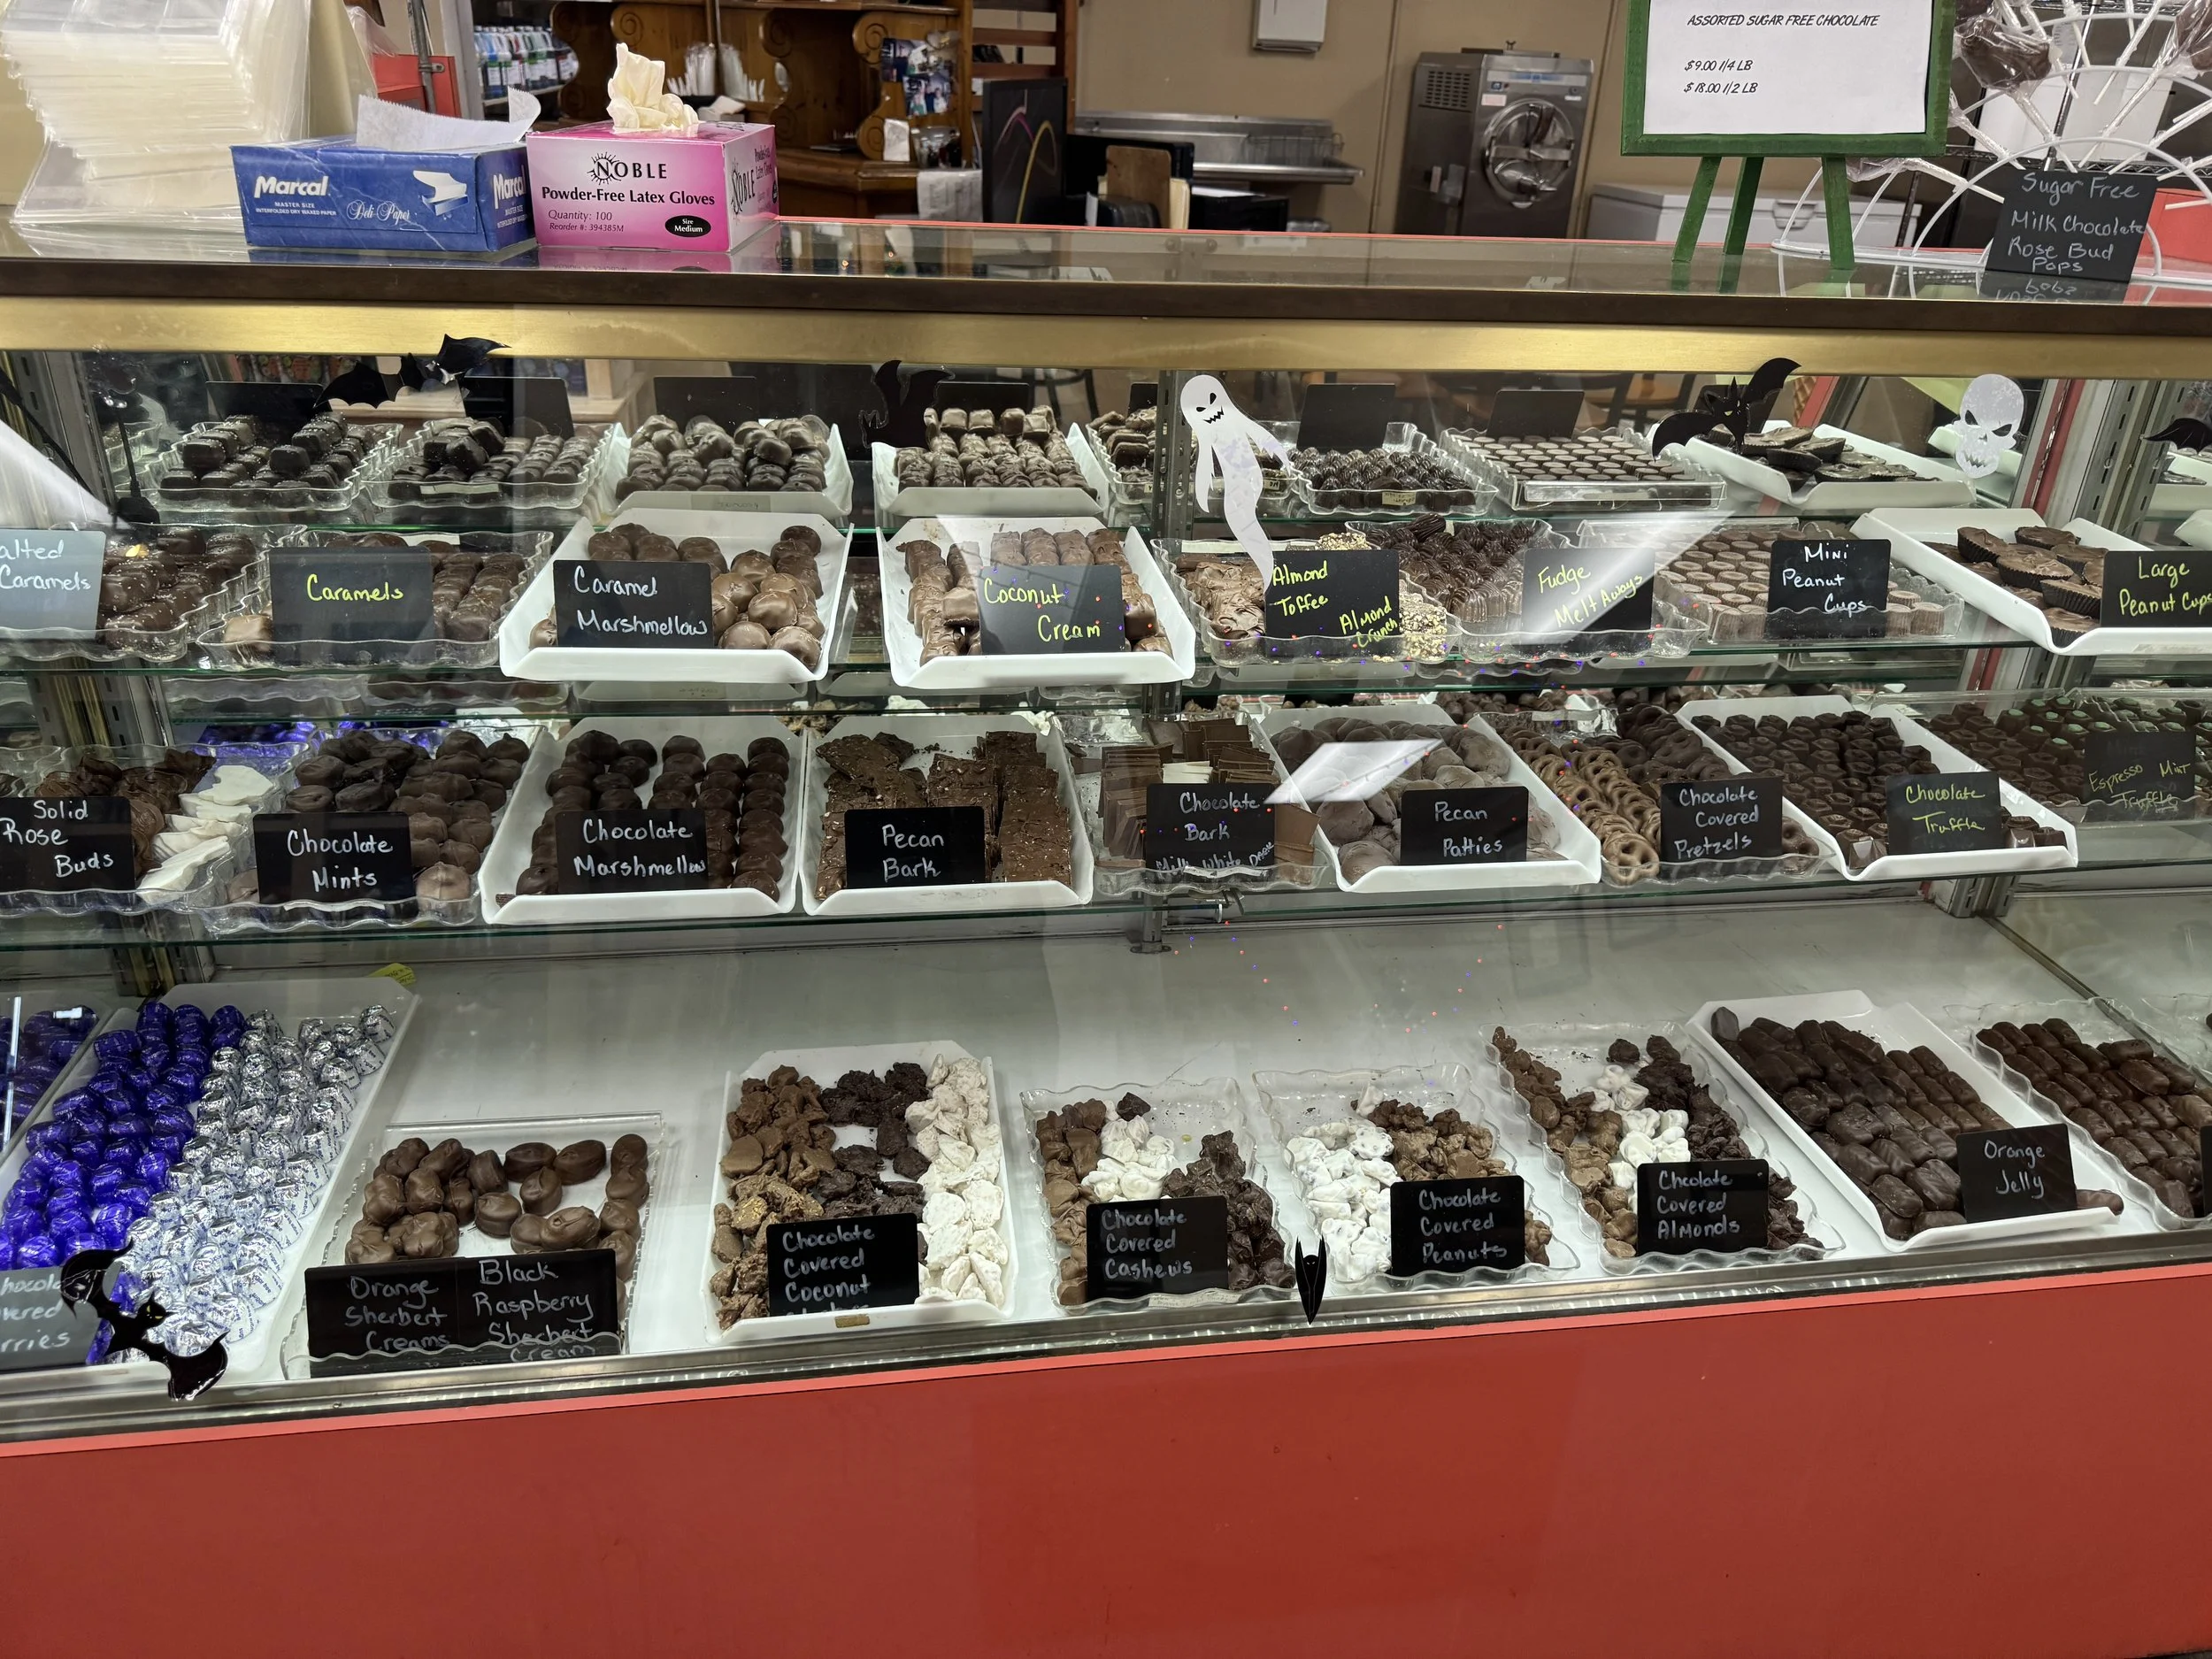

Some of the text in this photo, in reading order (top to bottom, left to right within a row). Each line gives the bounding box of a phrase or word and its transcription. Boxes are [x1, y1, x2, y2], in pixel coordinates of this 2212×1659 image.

[1686, 14, 1880, 27] ASSORTED SUGAR FREE CHOCOLATE
[1684, 58, 1754, 73] $9.00 1/4 LB
[1723, 81, 1740, 95] 1/2
[1741, 82, 1759, 94] LB
[254, 176, 329, 198] Marcal
[493, 165, 526, 210] Marcal
[541, 187, 715, 205] Powder-Free Latex Gloves
[2022, 173, 2139, 206] Sugar Free
[548, 210, 612, 220] Quantity: 100
[589, 223, 624, 232] 394385M
[2011, 210, 2147, 236] Milk Chocolate
[674, 225, 703, 234] Medium
[2008, 235, 2115, 261] Rose Bud
[2032, 257, 2084, 274] Pops
[0, 564, 91, 590] Caramels
[574, 565, 657, 598] Caramel
[1272, 560, 1328, 587] Almond
[1538, 565, 1592, 595] Fudge
[1782, 568, 1846, 588] Peanut
[2138, 556, 2190, 589] Large
[306, 573, 404, 603] Caramels
[984, 578, 1065, 605] Coconut
[1274, 593, 1329, 618] Toffee
[1554, 575, 1643, 628] Melt Aways
[1824, 592, 1867, 618] Cups
[2119, 588, 2176, 617] Peanut
[577, 609, 708, 636] Marshmellow
[1339, 595, 1392, 635] Almond
[1037, 615, 1101, 642] Cream
[1356, 617, 1399, 649] Crunch
[2088, 764, 2143, 794] Espresso
[1179, 791, 1261, 814] Chocolate
[1679, 786, 1758, 807] Chocolate
[1906, 784, 1985, 804] Chocolate
[34, 799, 88, 820] Solid
[1434, 801, 1488, 822] Pecan
[1695, 804, 1759, 828] Covered
[1912, 811, 1985, 834] Truffle
[0, 818, 69, 846] Rose
[287, 828, 394, 856] Chocolate
[582, 818, 694, 843] Chocolate
[881, 823, 945, 849] Pecan
[1184, 823, 1231, 841] Bark
[1443, 836, 1503, 857] Patties
[1673, 832, 1753, 860] Pretzels
[54, 852, 114, 878] Buds
[882, 856, 942, 884] Bark
[312, 865, 378, 893] Mints
[1984, 1139, 2046, 1169] Orange
[1996, 1170, 2044, 1200] Jelly
[1418, 1187, 1502, 1210] Chocolate
[1656, 1192, 1727, 1215] Covered
[1102, 1208, 1187, 1231] Chocolate
[1420, 1212, 1494, 1237] Covered
[1657, 1215, 1740, 1240] Almonds
[782, 1225, 875, 1253] Chocolate
[1106, 1228, 1176, 1254] Covered
[1422, 1240, 1508, 1264] Peanuts
[479, 1260, 559, 1285] Black
[783, 1248, 864, 1279] Covered
[1105, 1258, 1193, 1279] Cashews
[0, 1273, 62, 1296] hocola
[349, 1276, 438, 1310] Orange
[785, 1274, 872, 1302] Coconut
[345, 1305, 448, 1327] Sherbert
[472, 1289, 594, 1323] Raspberry
[365, 1331, 450, 1352] Creams
[510, 1345, 595, 1363] Cream
